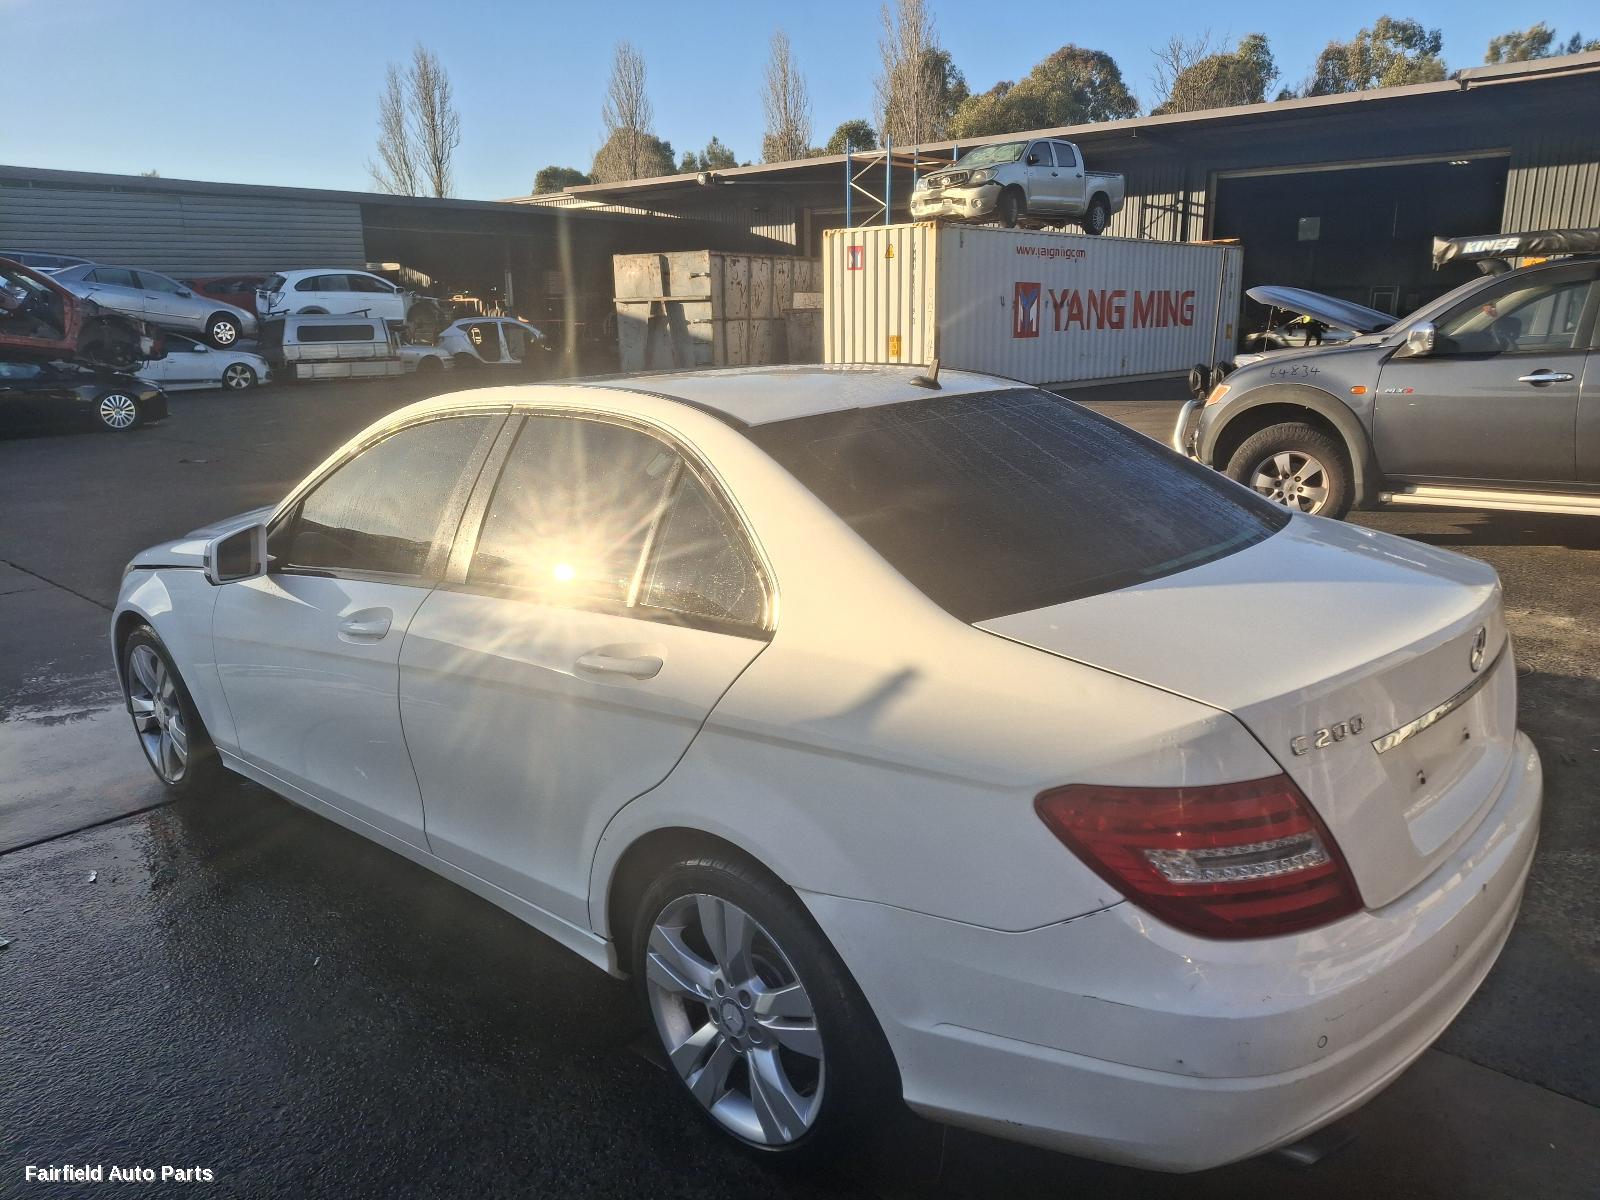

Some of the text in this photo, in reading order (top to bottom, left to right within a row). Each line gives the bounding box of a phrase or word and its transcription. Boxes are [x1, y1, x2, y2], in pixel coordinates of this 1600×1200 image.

[1462, 237, 1521, 254] KINGS
[1048, 288, 1196, 332] YANG MING
[1290, 714, 1366, 756] C 200
